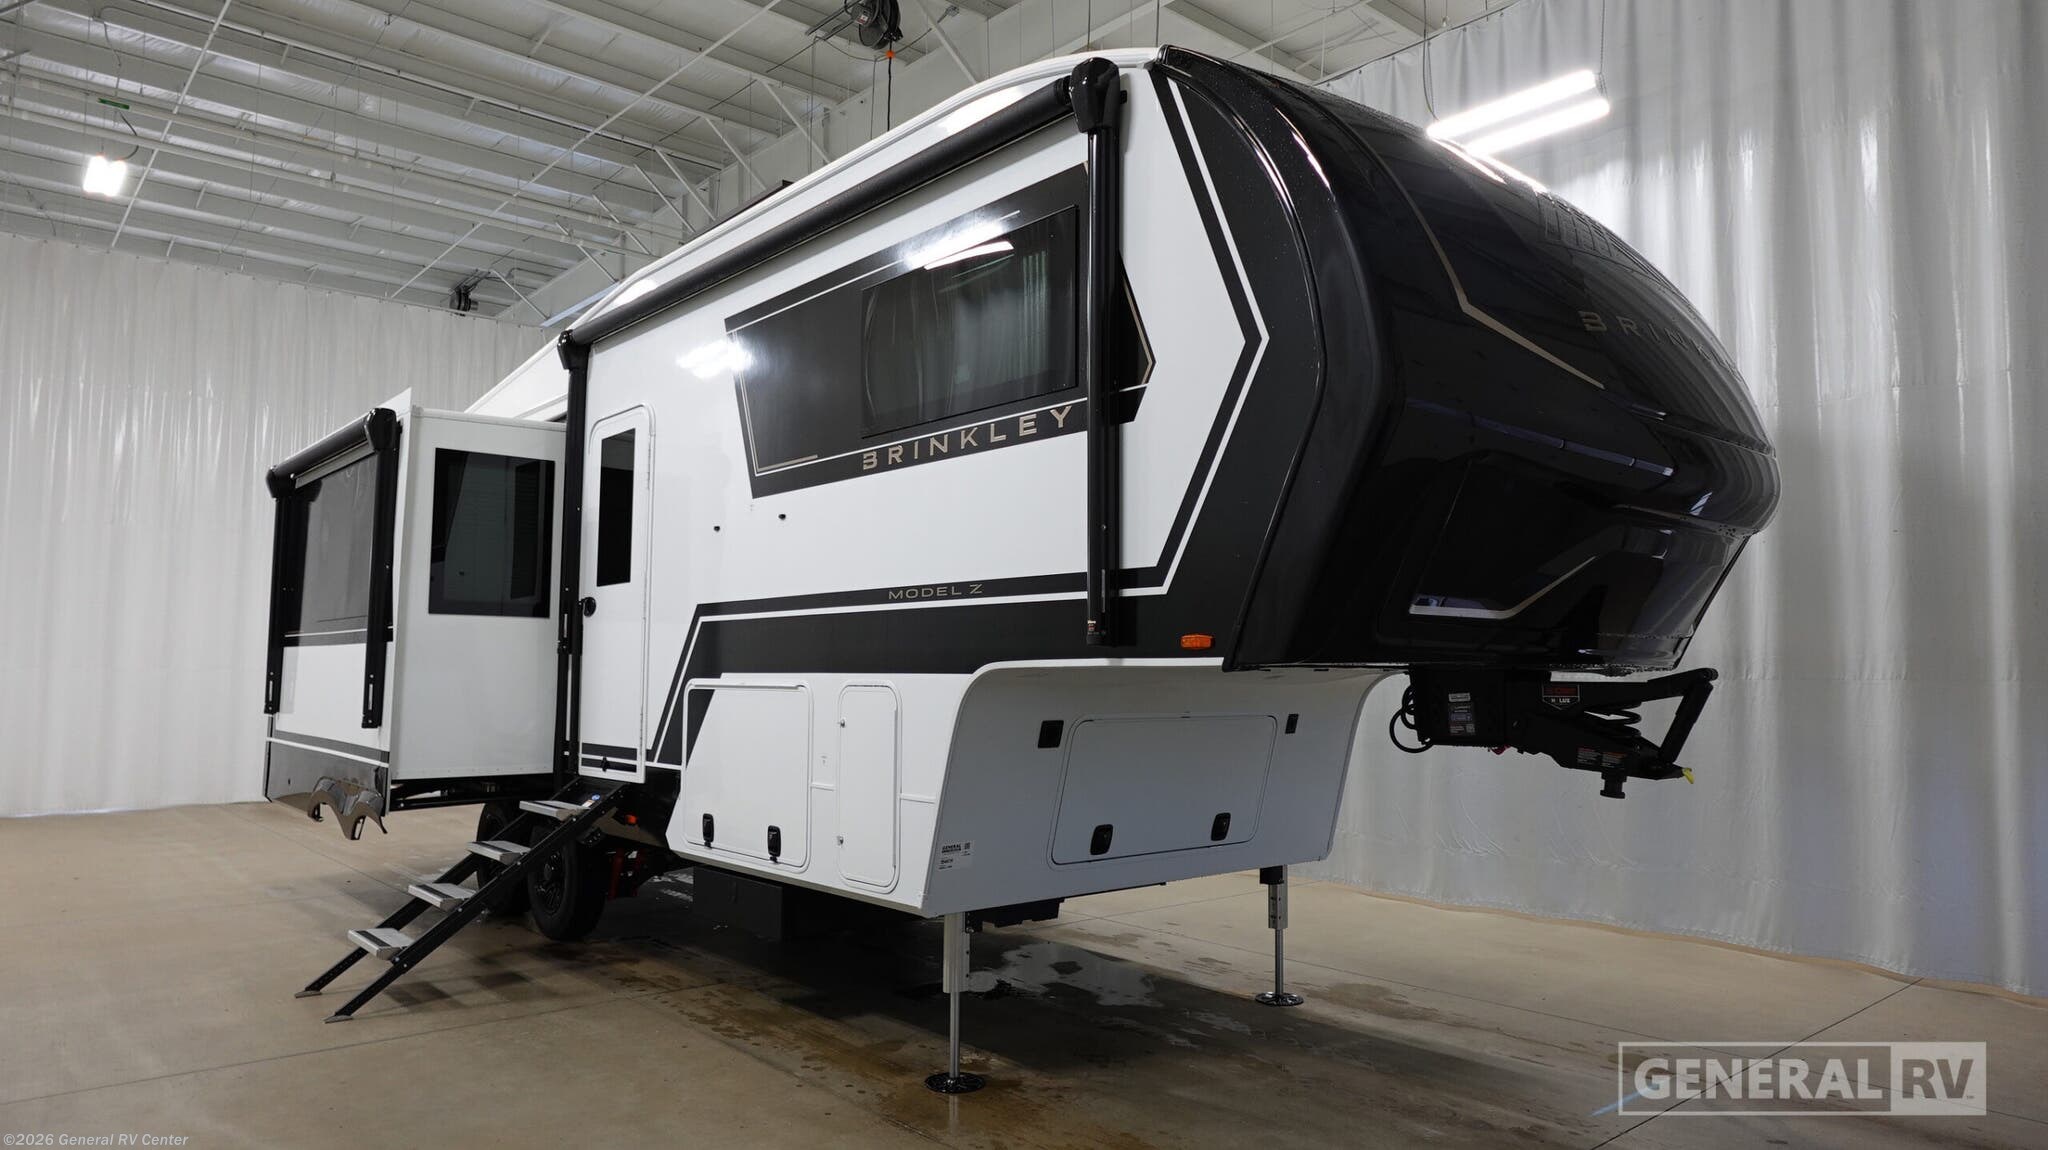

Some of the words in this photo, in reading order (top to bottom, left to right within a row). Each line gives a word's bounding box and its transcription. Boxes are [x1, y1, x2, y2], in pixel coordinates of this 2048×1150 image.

[862, 405, 1072, 470] BRINKLEY
[888, 586, 962, 600] MODEL
[969, 583, 983, 594] Z
